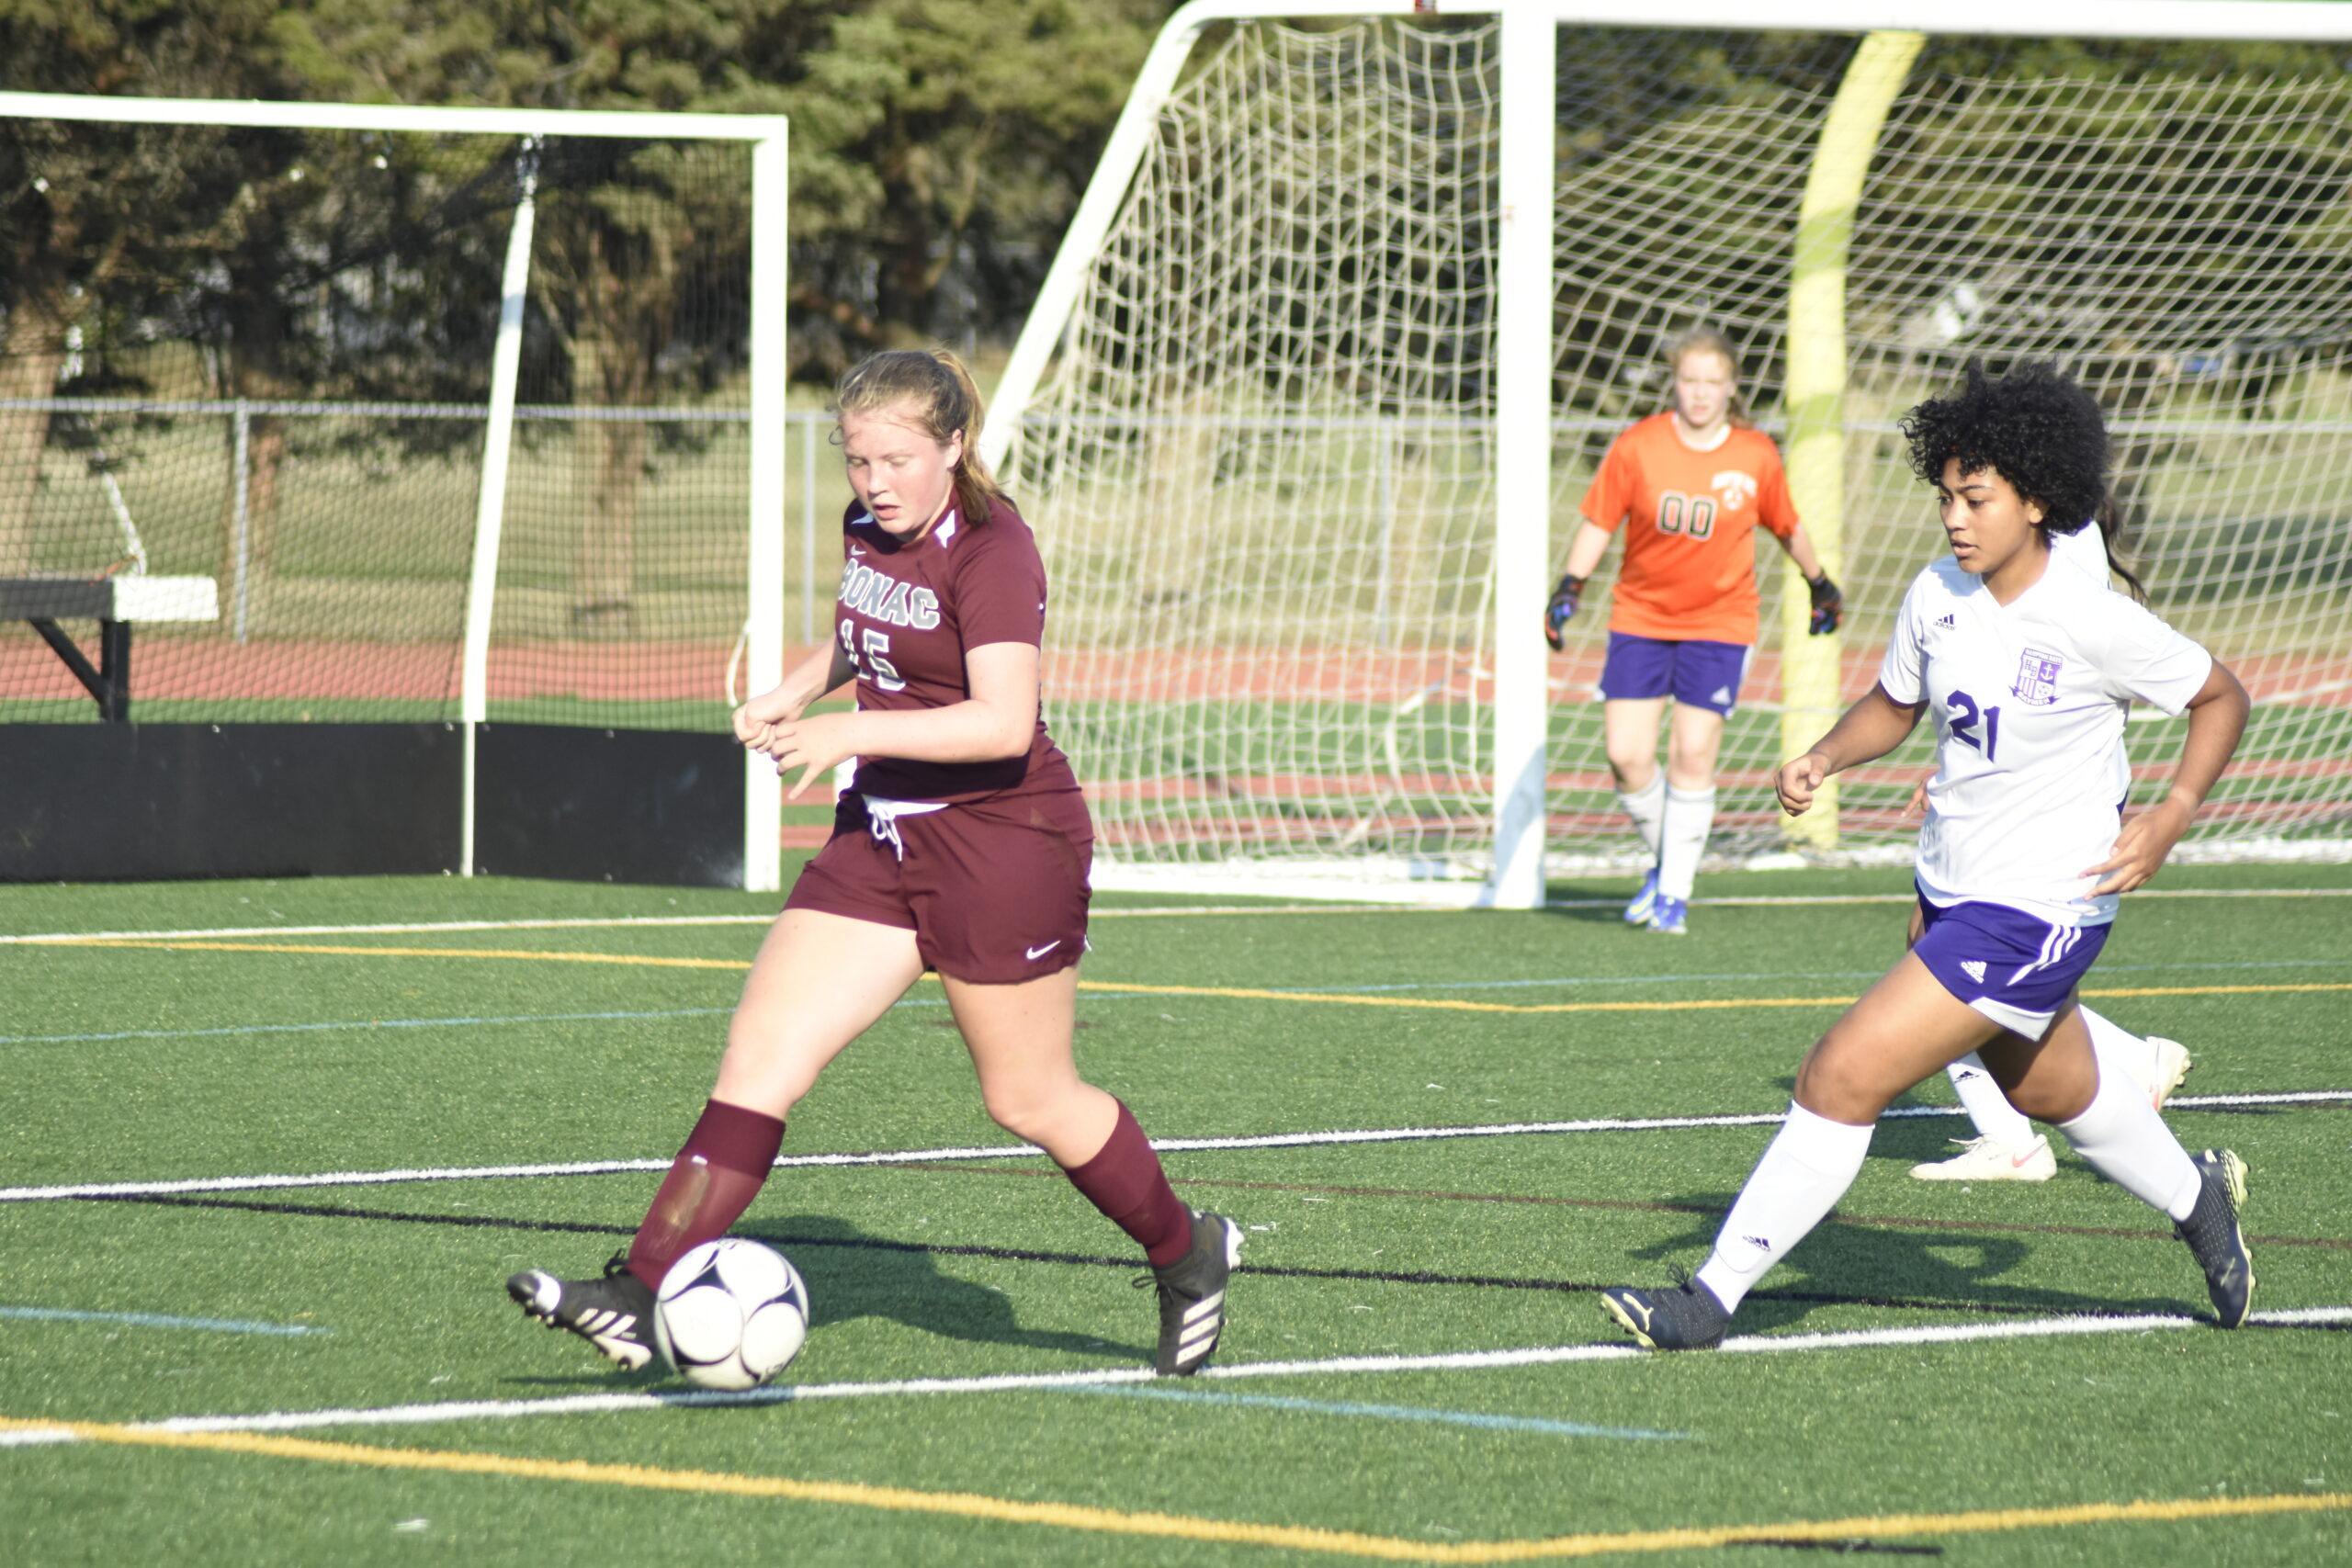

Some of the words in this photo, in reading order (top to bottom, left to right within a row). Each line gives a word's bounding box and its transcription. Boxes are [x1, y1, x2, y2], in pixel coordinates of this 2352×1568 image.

[1657, 490, 1717, 542] 00
[838, 558, 941, 630] BONAC
[1933, 621, 1956, 632] adidas
[1947, 690, 2001, 764] 21
